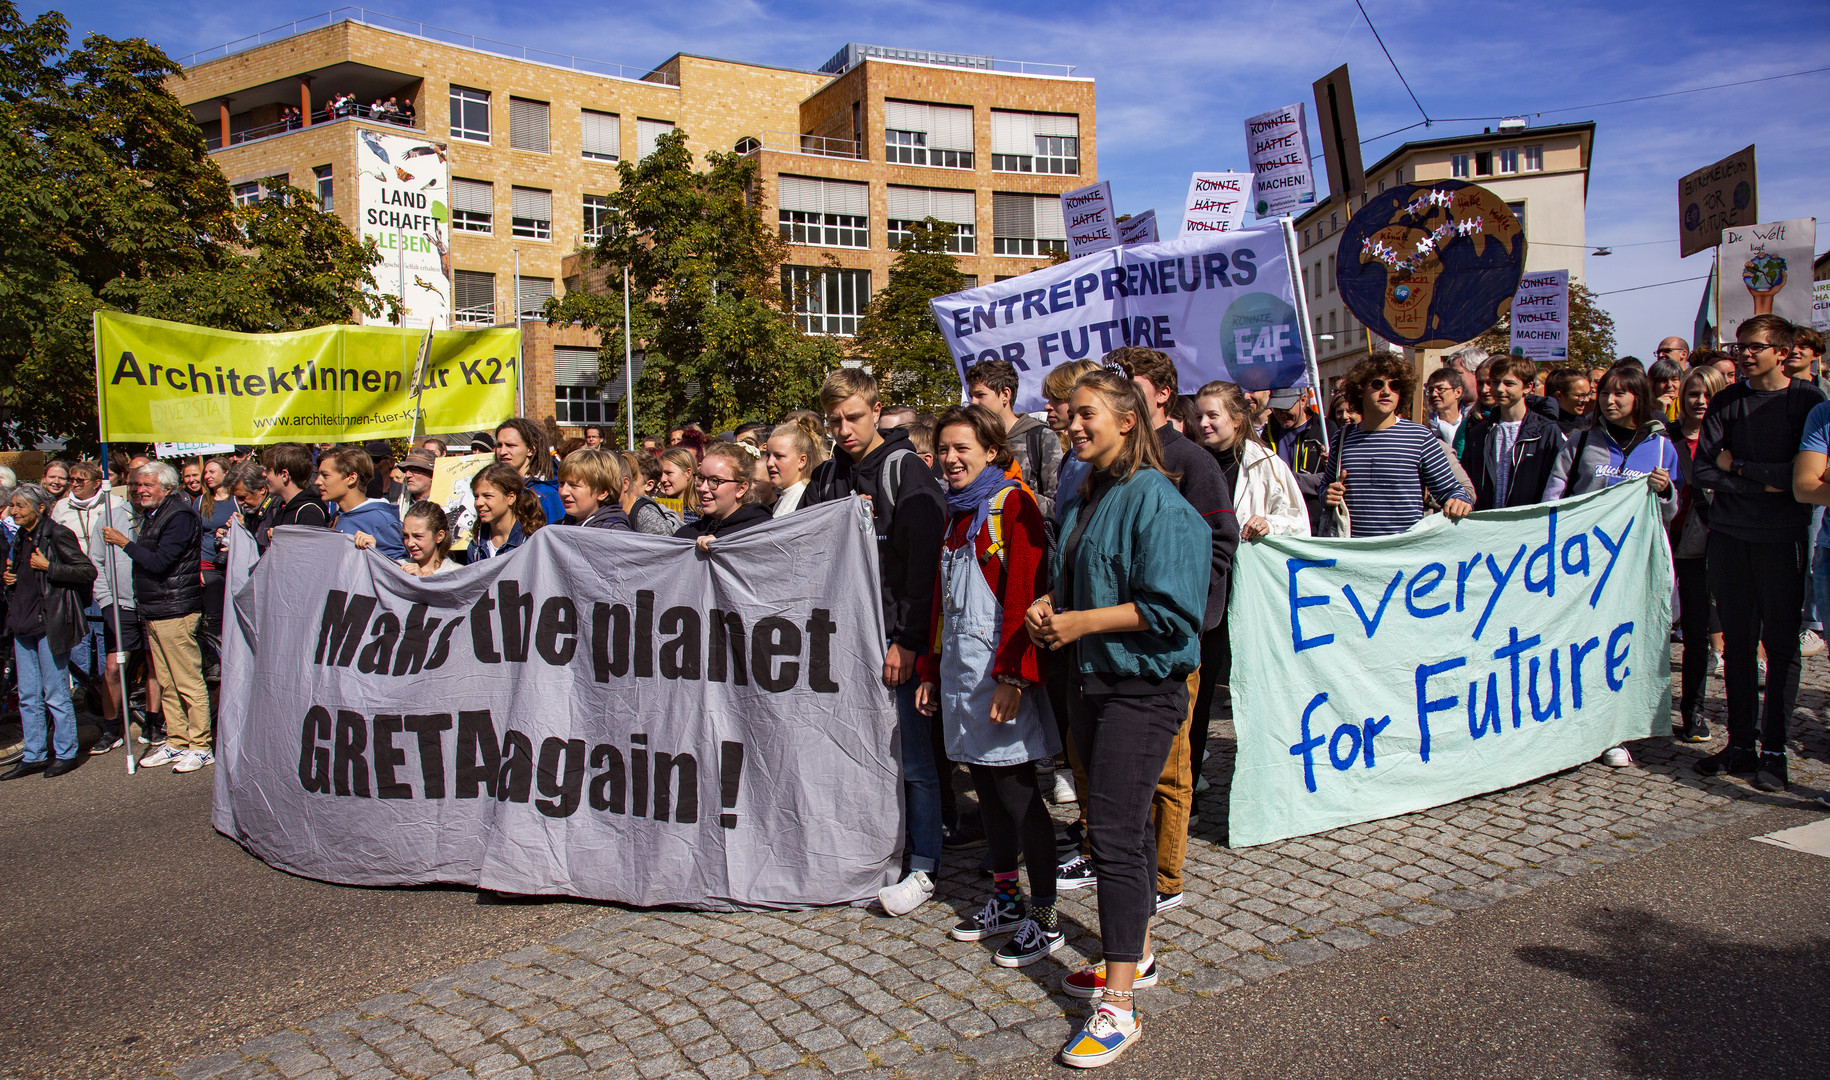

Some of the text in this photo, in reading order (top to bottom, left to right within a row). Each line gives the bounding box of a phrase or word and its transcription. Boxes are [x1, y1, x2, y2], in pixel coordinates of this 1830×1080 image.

[1251, 113, 1295, 136] KÖNNTE.
[1256, 135, 1295, 152] HÄTTE.
[1256, 152, 1302, 174] WOLLTE.
[1196, 178, 1240, 192] KÖNNTE.
[1258, 174, 1306, 192] MACHEN!
[381, 187, 426, 209] LAND
[1194, 198, 1232, 214] HÄTTE.
[1703, 190, 1726, 209] FOR
[367, 208, 440, 232] SCHAFFT
[1072, 212, 1105, 226] HÄTTE.
[1186, 218, 1231, 232] WOLLTE.
[379, 231, 431, 254] LEBEN
[1073, 227, 1111, 247] WOLLTE.
[1728, 225, 1787, 244] Die Welt
[953, 248, 1257, 339] ENTREPRENEURS
[1519, 295, 1557, 306] HÄTTE.
[1518, 311, 1560, 324] WOLLTE.
[1233, 324, 1291, 365] E4F
[1516, 330, 1561, 341] MACHEN!
[110, 350, 401, 397] ArchitektInnen
[421, 362, 450, 391] ür
[459, 356, 516, 386] K21
[1286, 506, 1635, 653] Everyday
[470, 579, 579, 666] the
[592, 588, 840, 694] planet
[1289, 621, 1635, 793] for Future
[299, 704, 497, 799] GRETA
[497, 728, 700, 823] again
